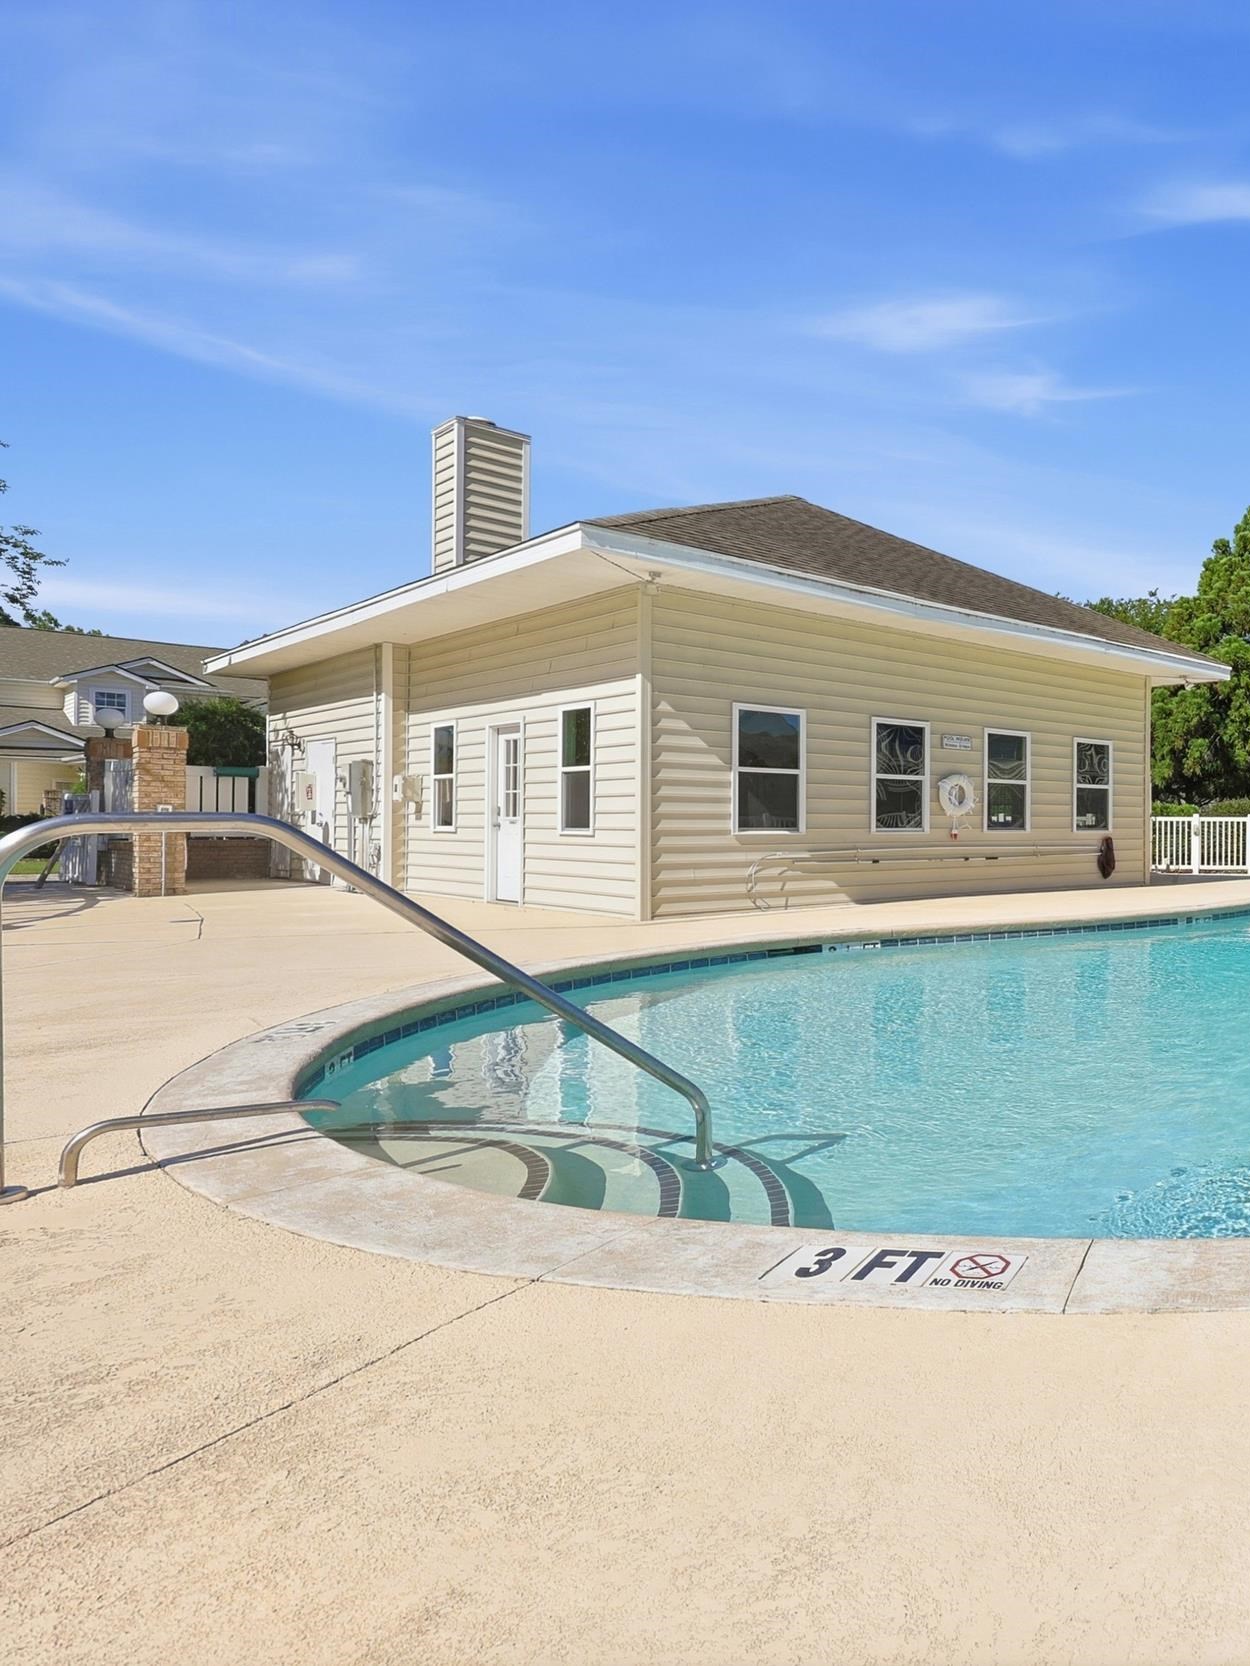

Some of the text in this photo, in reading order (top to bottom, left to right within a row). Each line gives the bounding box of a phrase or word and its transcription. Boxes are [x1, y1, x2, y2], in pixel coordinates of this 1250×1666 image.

[794, 1247, 945, 1283] 3 FT
[929, 1278, 1004, 1290] NO DIVING
